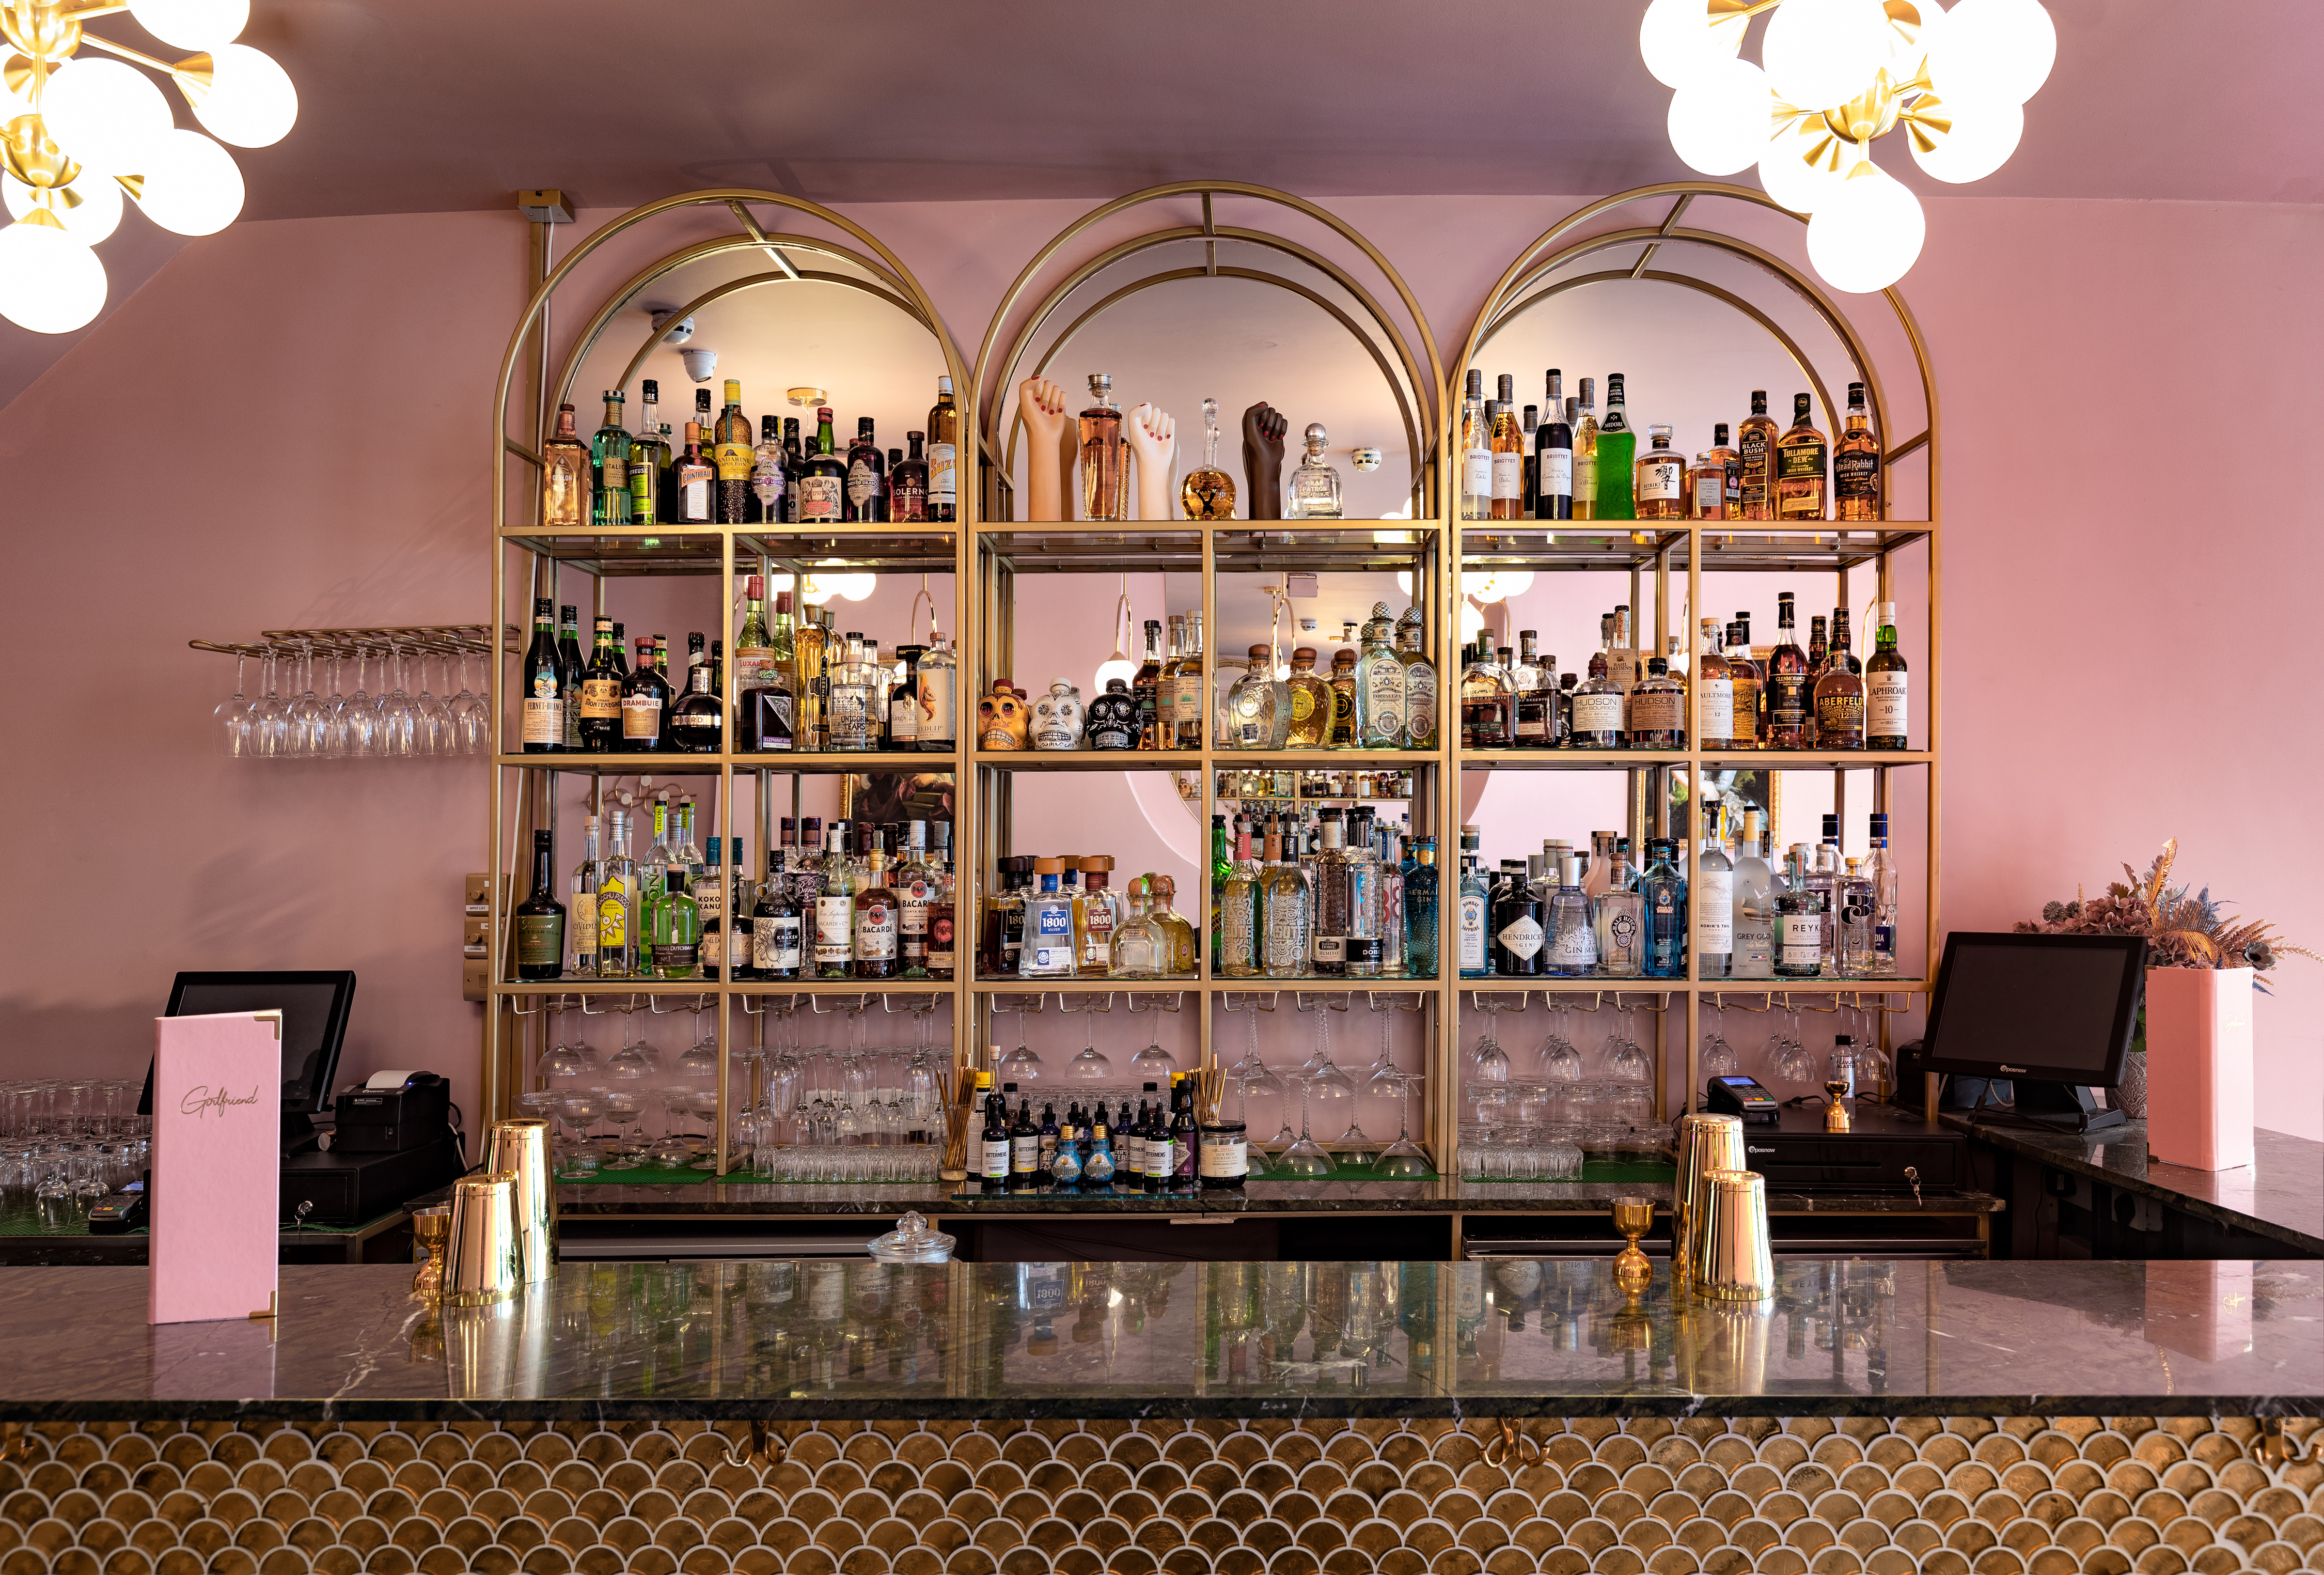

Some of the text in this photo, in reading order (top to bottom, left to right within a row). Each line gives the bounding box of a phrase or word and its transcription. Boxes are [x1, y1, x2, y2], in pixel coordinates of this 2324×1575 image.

[1783, 447, 1818, 458] TULLAMORE
[1835, 459, 1874, 473] Dead Rabbit
[683, 471, 710, 484] COINTREAU
[1869, 687, 1906, 696] LAPHROAIG
[528, 702, 561, 711] FERNET-BRANCA
[585, 698, 621, 708] MONTENEGRO
[1635, 697, 1675, 706] HUDSON
[1823, 705, 1842, 714] HIGHLAND
[1885, 705, 1893, 713] 10
[597, 893, 630, 908] MACCHU PISCO
[826, 908, 850, 918] Superior
[520, 918, 554, 930] Somerset
[1042, 917, 1066, 927] 1800
[1090, 915, 1110, 925] 1800
[1613, 916, 1636, 930] HALF HITCH
[862, 924, 892, 933] BACARDÍ
[2000, 1065, 2027, 1074] eposnow
[179, 1085, 259, 1119] Girlfriend
[1748, 1145, 1775, 1154] eposnow
